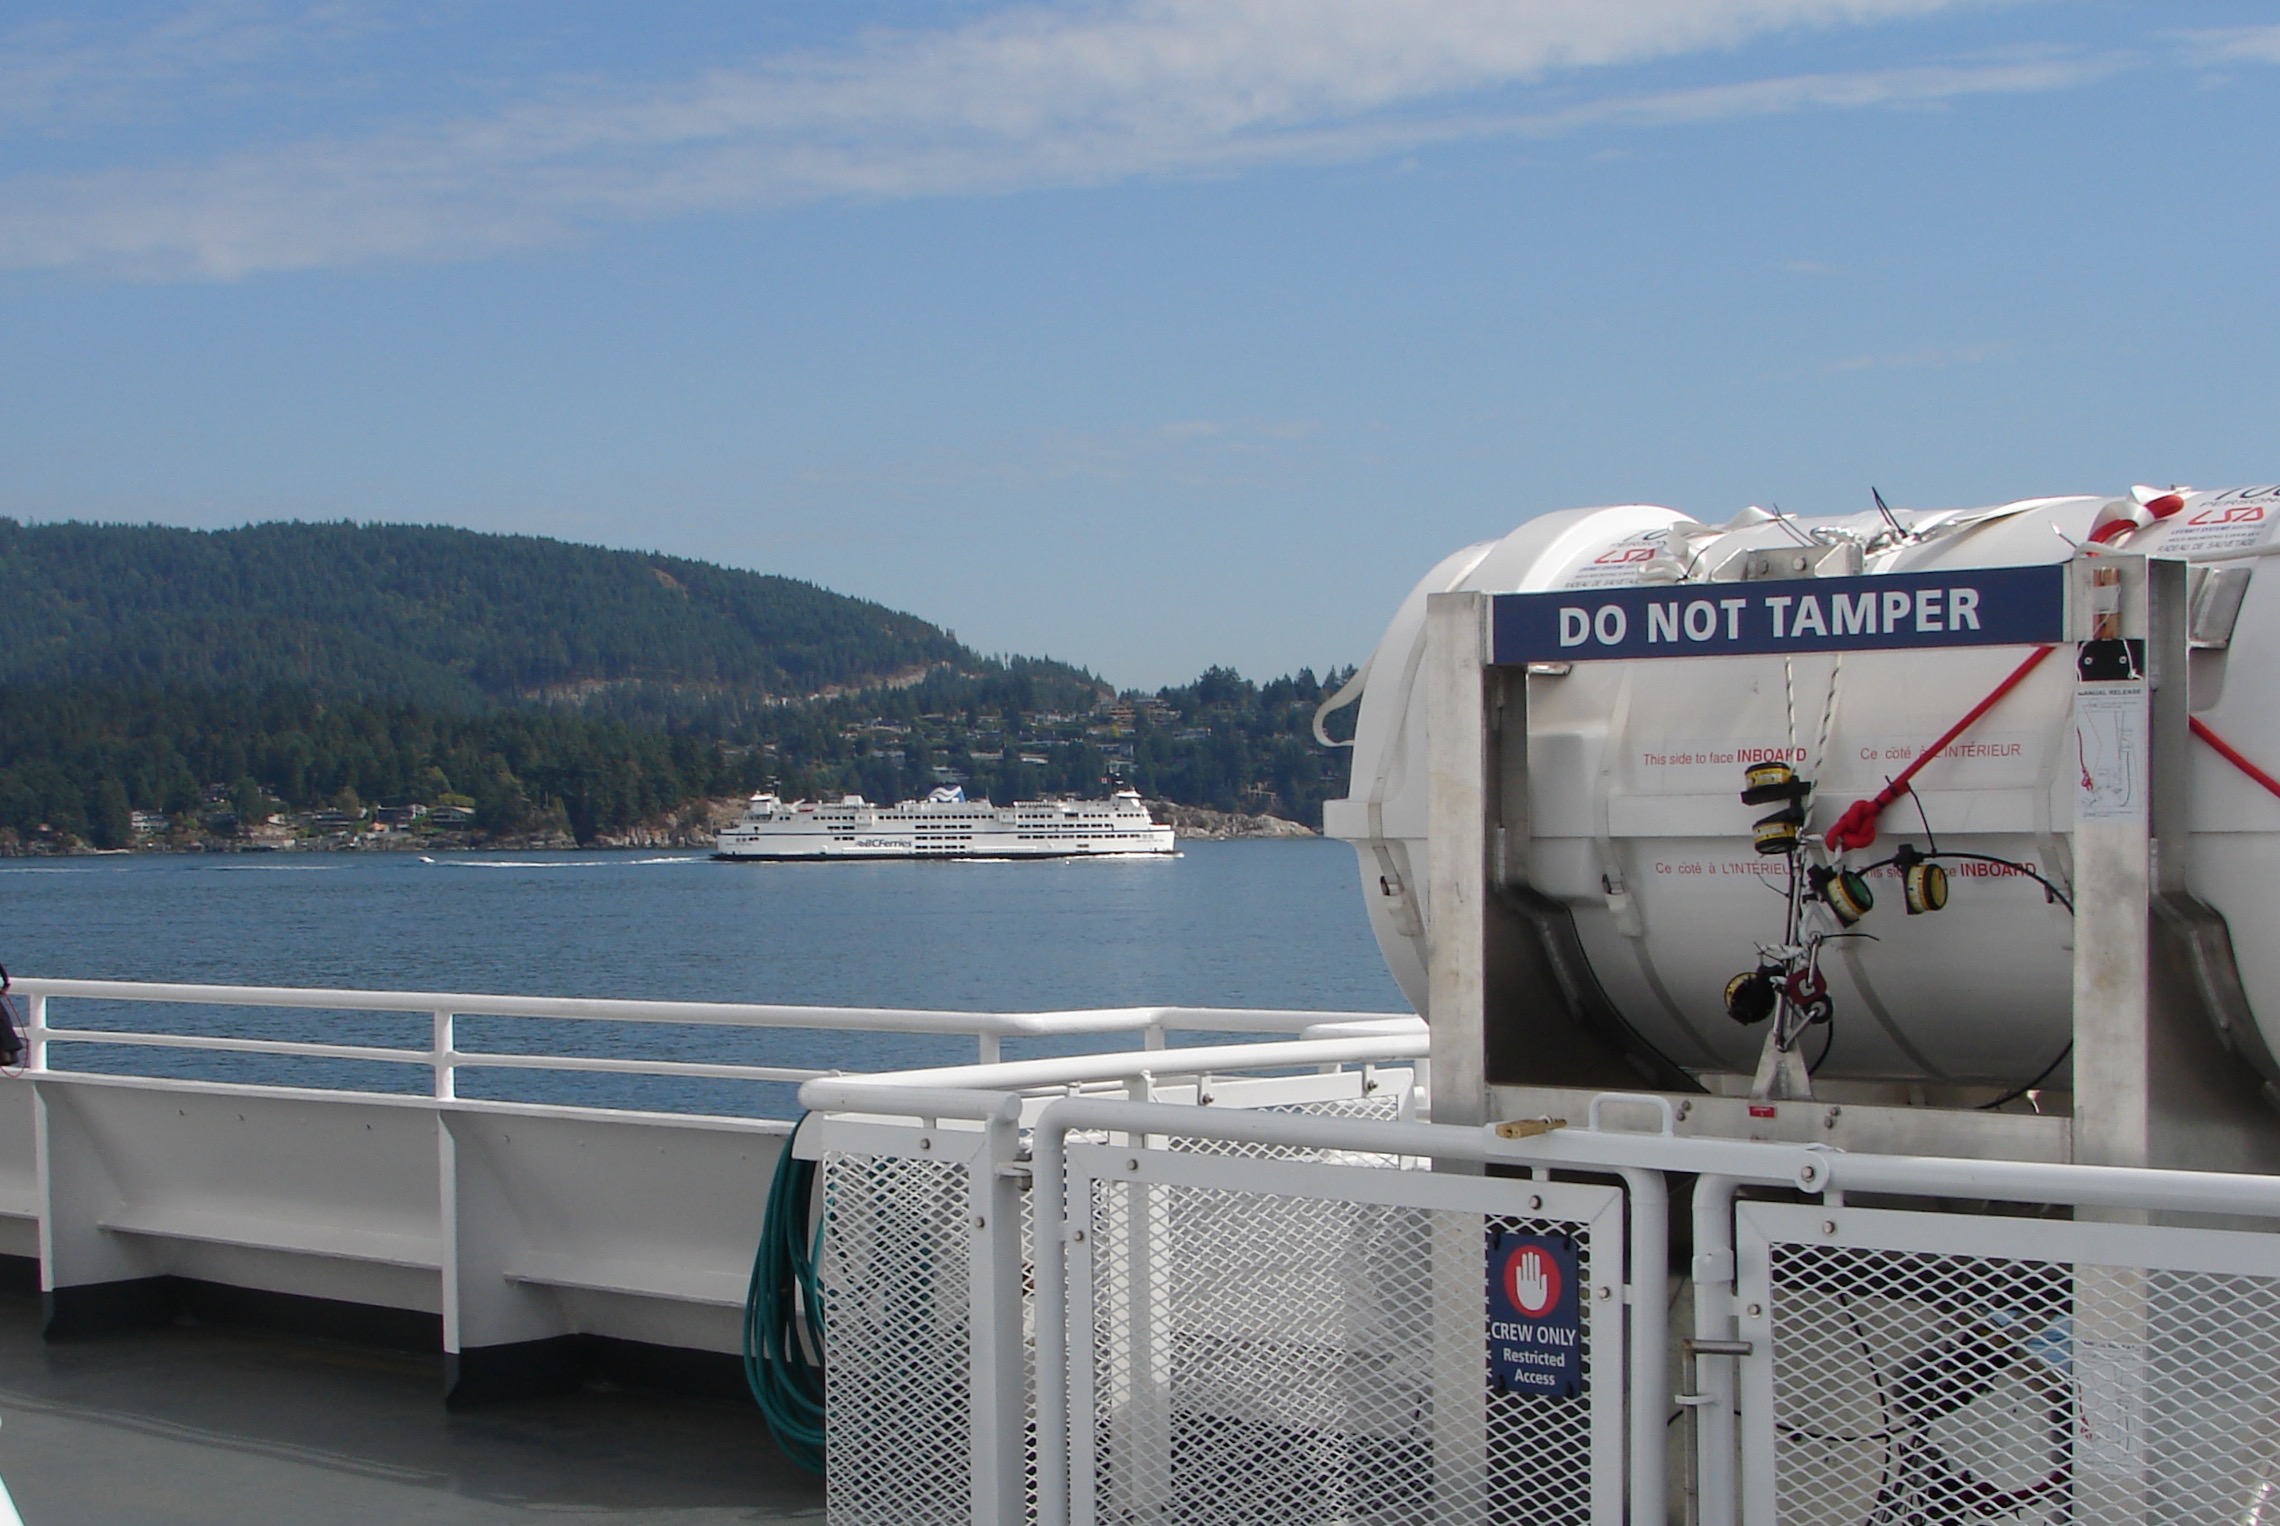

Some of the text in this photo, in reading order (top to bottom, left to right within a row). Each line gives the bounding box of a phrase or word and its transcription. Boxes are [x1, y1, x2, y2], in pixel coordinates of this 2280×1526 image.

[1559, 588, 1981, 647] DO NOT TAMPER
[1643, 753, 1666, 766] This
[1669, 752, 1692, 765] side
[1695, 752, 1707, 765] to
[1709, 751, 1734, 764] face
[1860, 747, 1878, 760] Ce
[1933, 741, 2022, 758] INTÉRIEUR
[1655, 862, 1672, 875] Ce
[1721, 860, 1791, 875] L'INTÉRIEU
[1960, 861, 2037, 878] INBOARD
[1491, 1321, 1577, 1346] CREW ONLY
[1503, 1347, 1565, 1367] Restricted
[1514, 1368, 1556, 1386] Access
